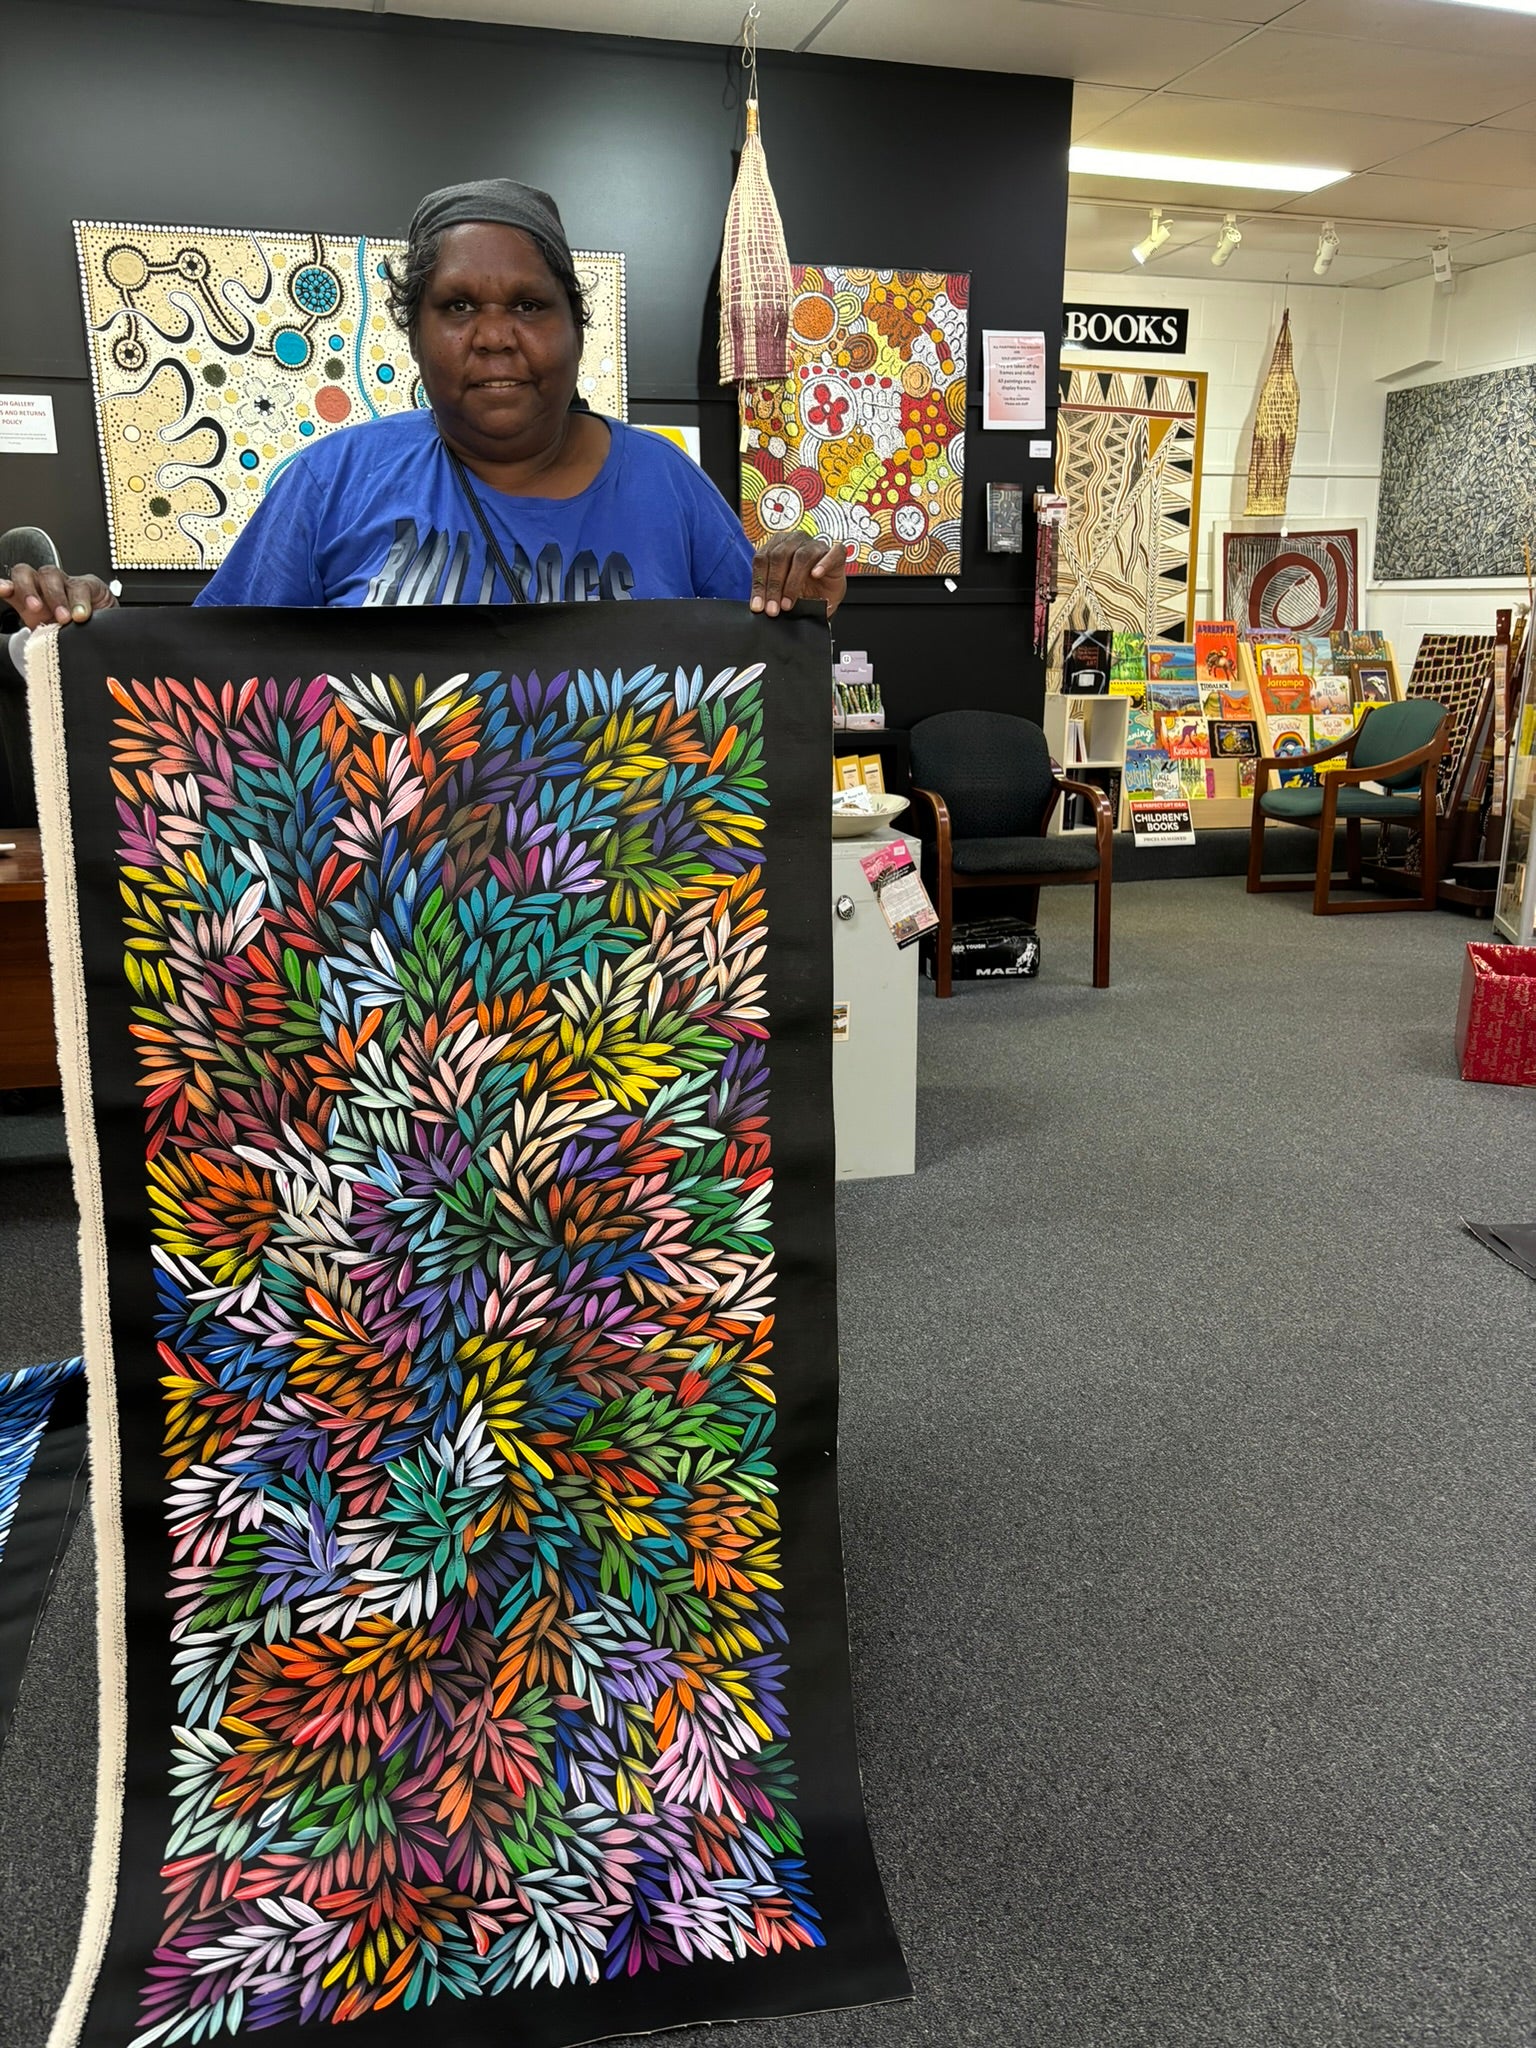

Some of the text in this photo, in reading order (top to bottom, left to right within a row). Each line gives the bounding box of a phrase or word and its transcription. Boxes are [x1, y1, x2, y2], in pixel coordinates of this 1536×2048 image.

[1064, 311, 1178, 345] BOOKS
[1267, 678, 1304, 688] Jarrampa
[1135, 812, 1189, 822] CHILDREN'S
[1147, 822, 1180, 832] BOOKS
[976, 967, 1030, 976] MACK
